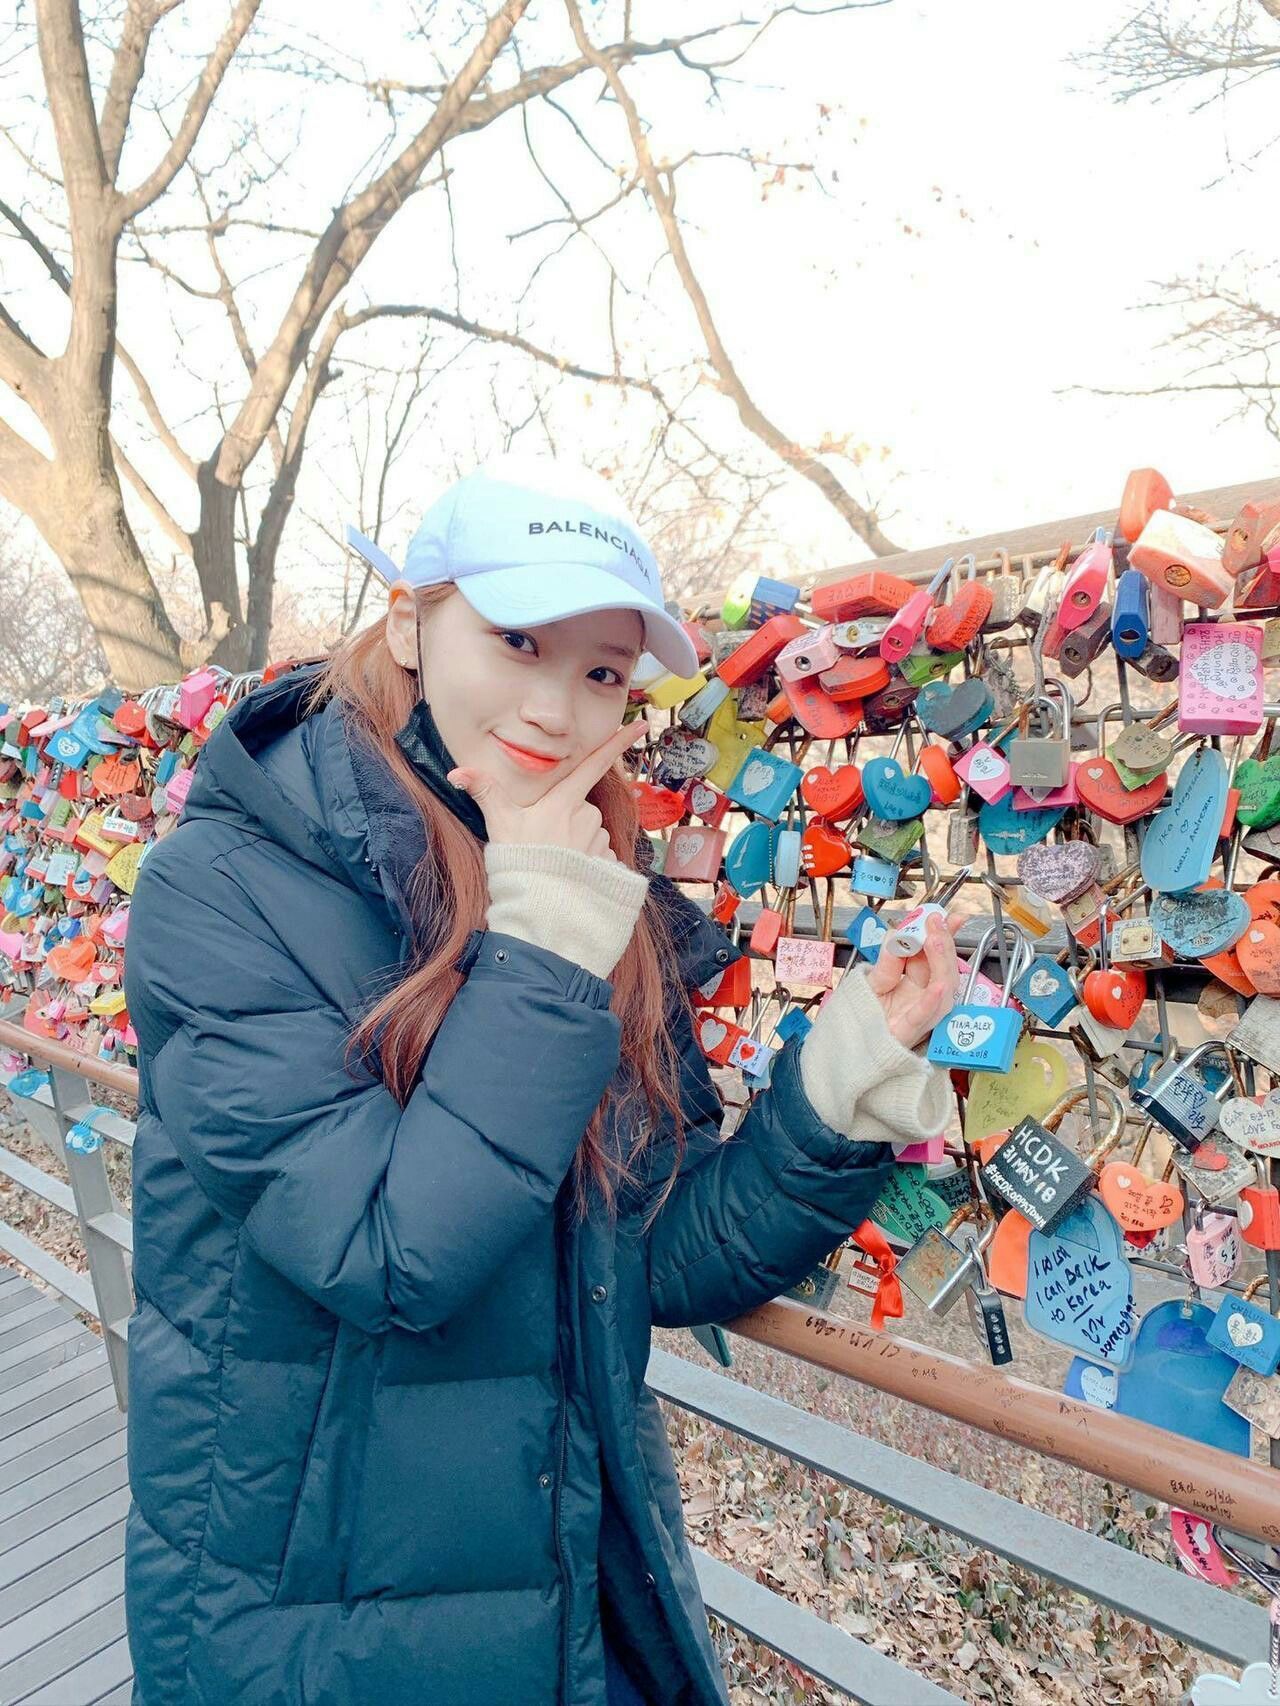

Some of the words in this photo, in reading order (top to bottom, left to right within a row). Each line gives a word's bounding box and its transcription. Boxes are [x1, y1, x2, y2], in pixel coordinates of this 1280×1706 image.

[970, 1049, 989, 1059] 2018
[1243, 1122, 1266, 1136] LOVE
[1014, 1124, 1069, 1184] HCDK
[1002, 1144, 1018, 1164] 31
[1011, 1157, 1040, 1186] MAY
[1034, 1181, 1056, 1204] 18
[1066, 1279, 1112, 1312] Korea
